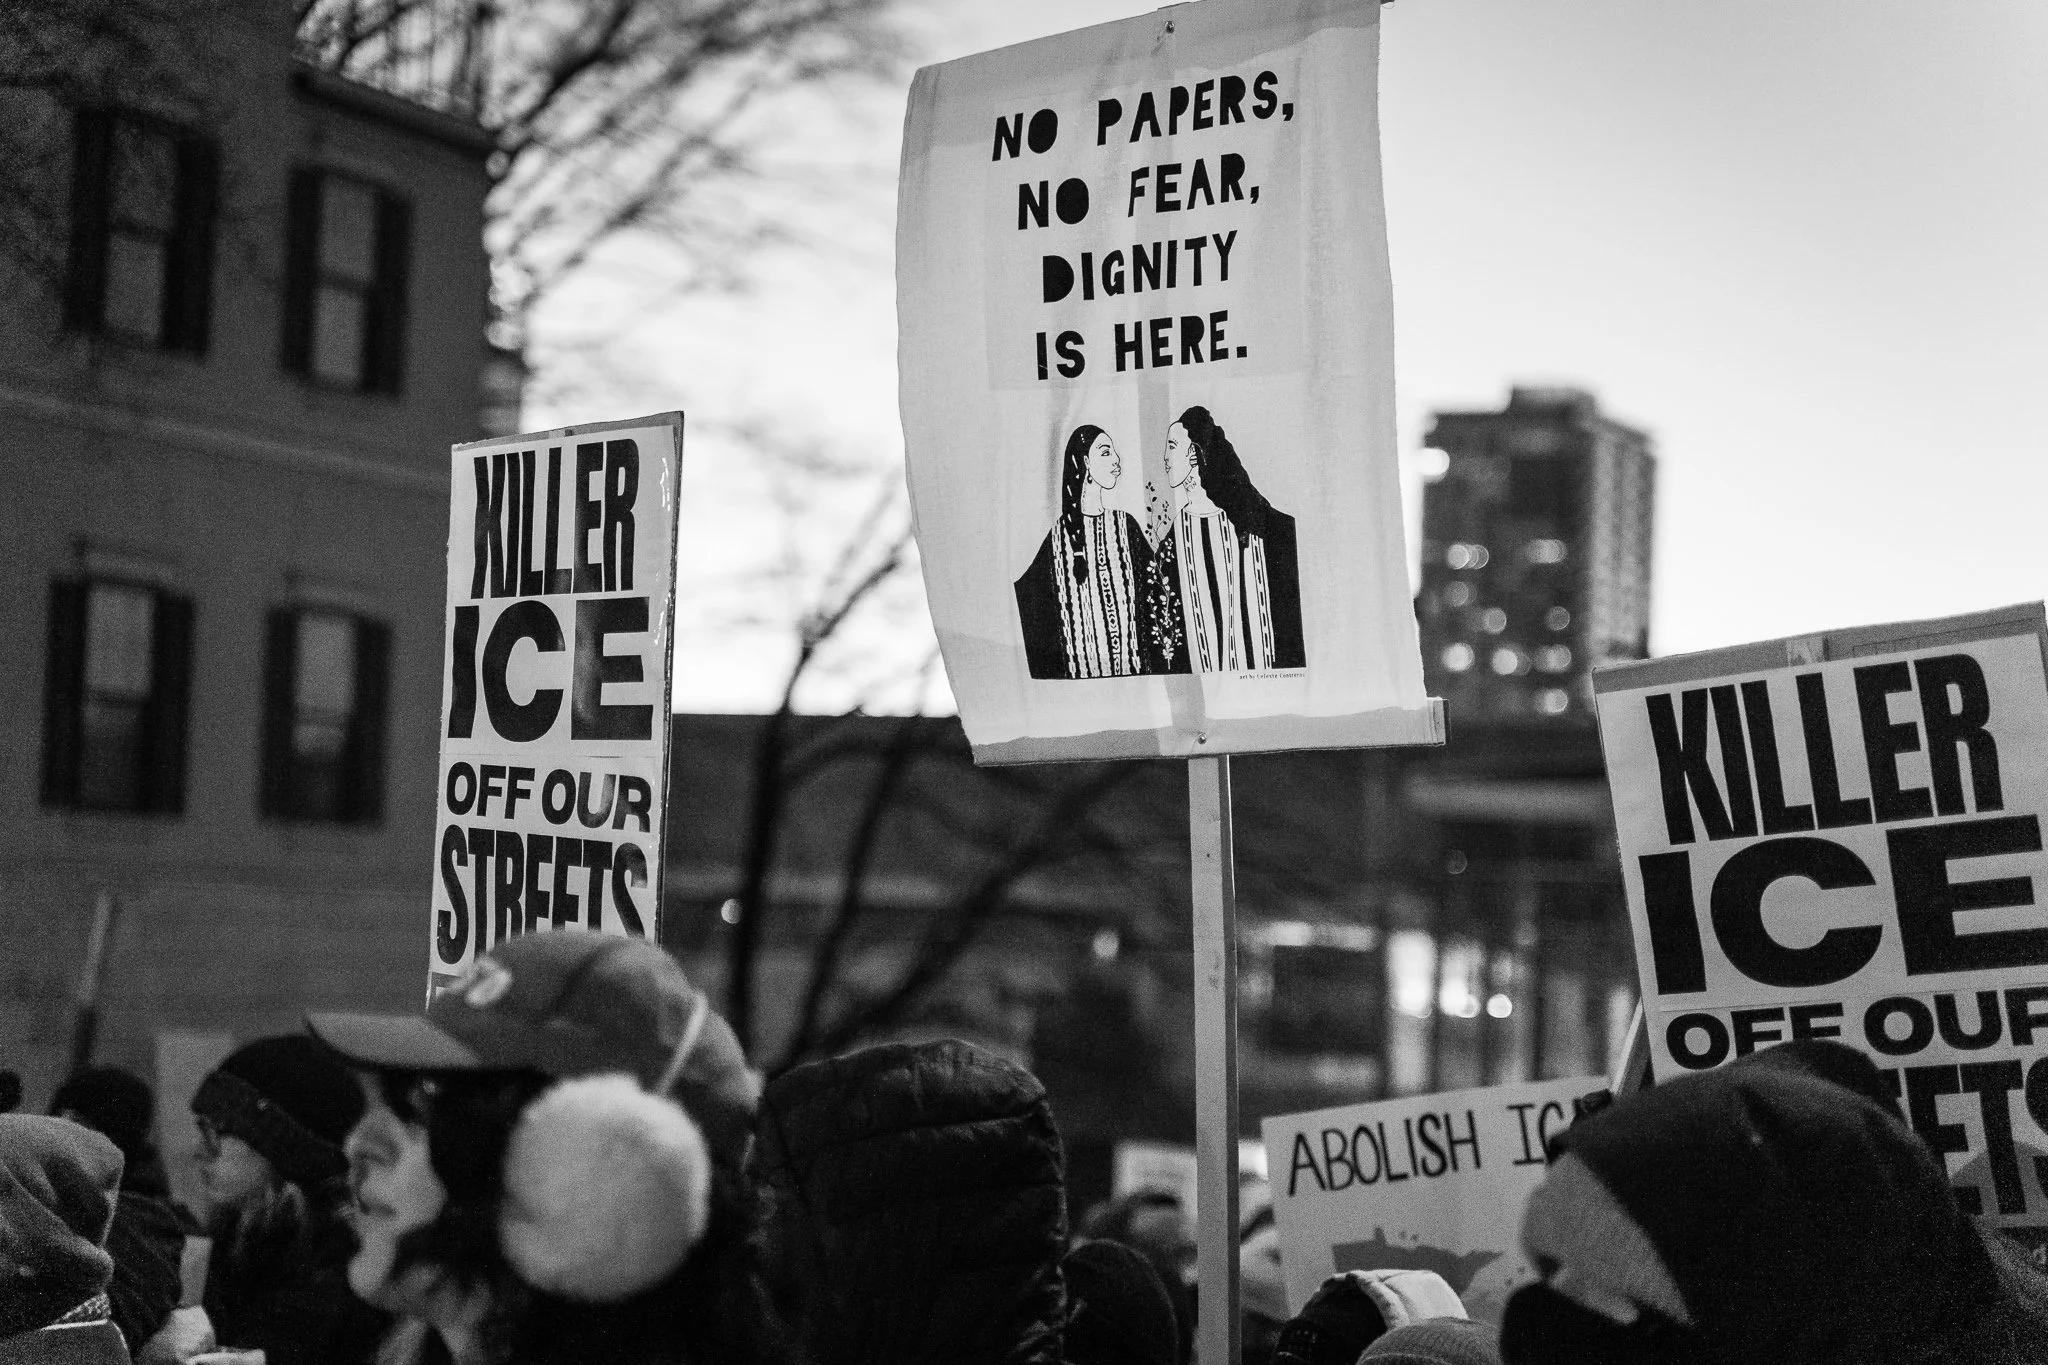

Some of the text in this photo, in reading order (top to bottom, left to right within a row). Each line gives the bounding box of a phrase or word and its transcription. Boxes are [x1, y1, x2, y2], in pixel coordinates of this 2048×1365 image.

[992, 70, 1294, 161] NO PAPERS,
[1018, 152, 1260, 230] NO FEAR,
[1042, 230, 1238, 303] DIGNITY
[1036, 310, 1248, 380] IS HERE.
[471, 438, 639, 599] KILLER
[448, 597, 653, 742] ICE
[1645, 653, 2004, 845] KILLER
[446, 761, 651, 833] OFF OUR
[1638, 814, 2048, 995] ICE
[1666, 1002, 1844, 1070] OFF
[1288, 1102, 1565, 1197] ABOLISH IC
